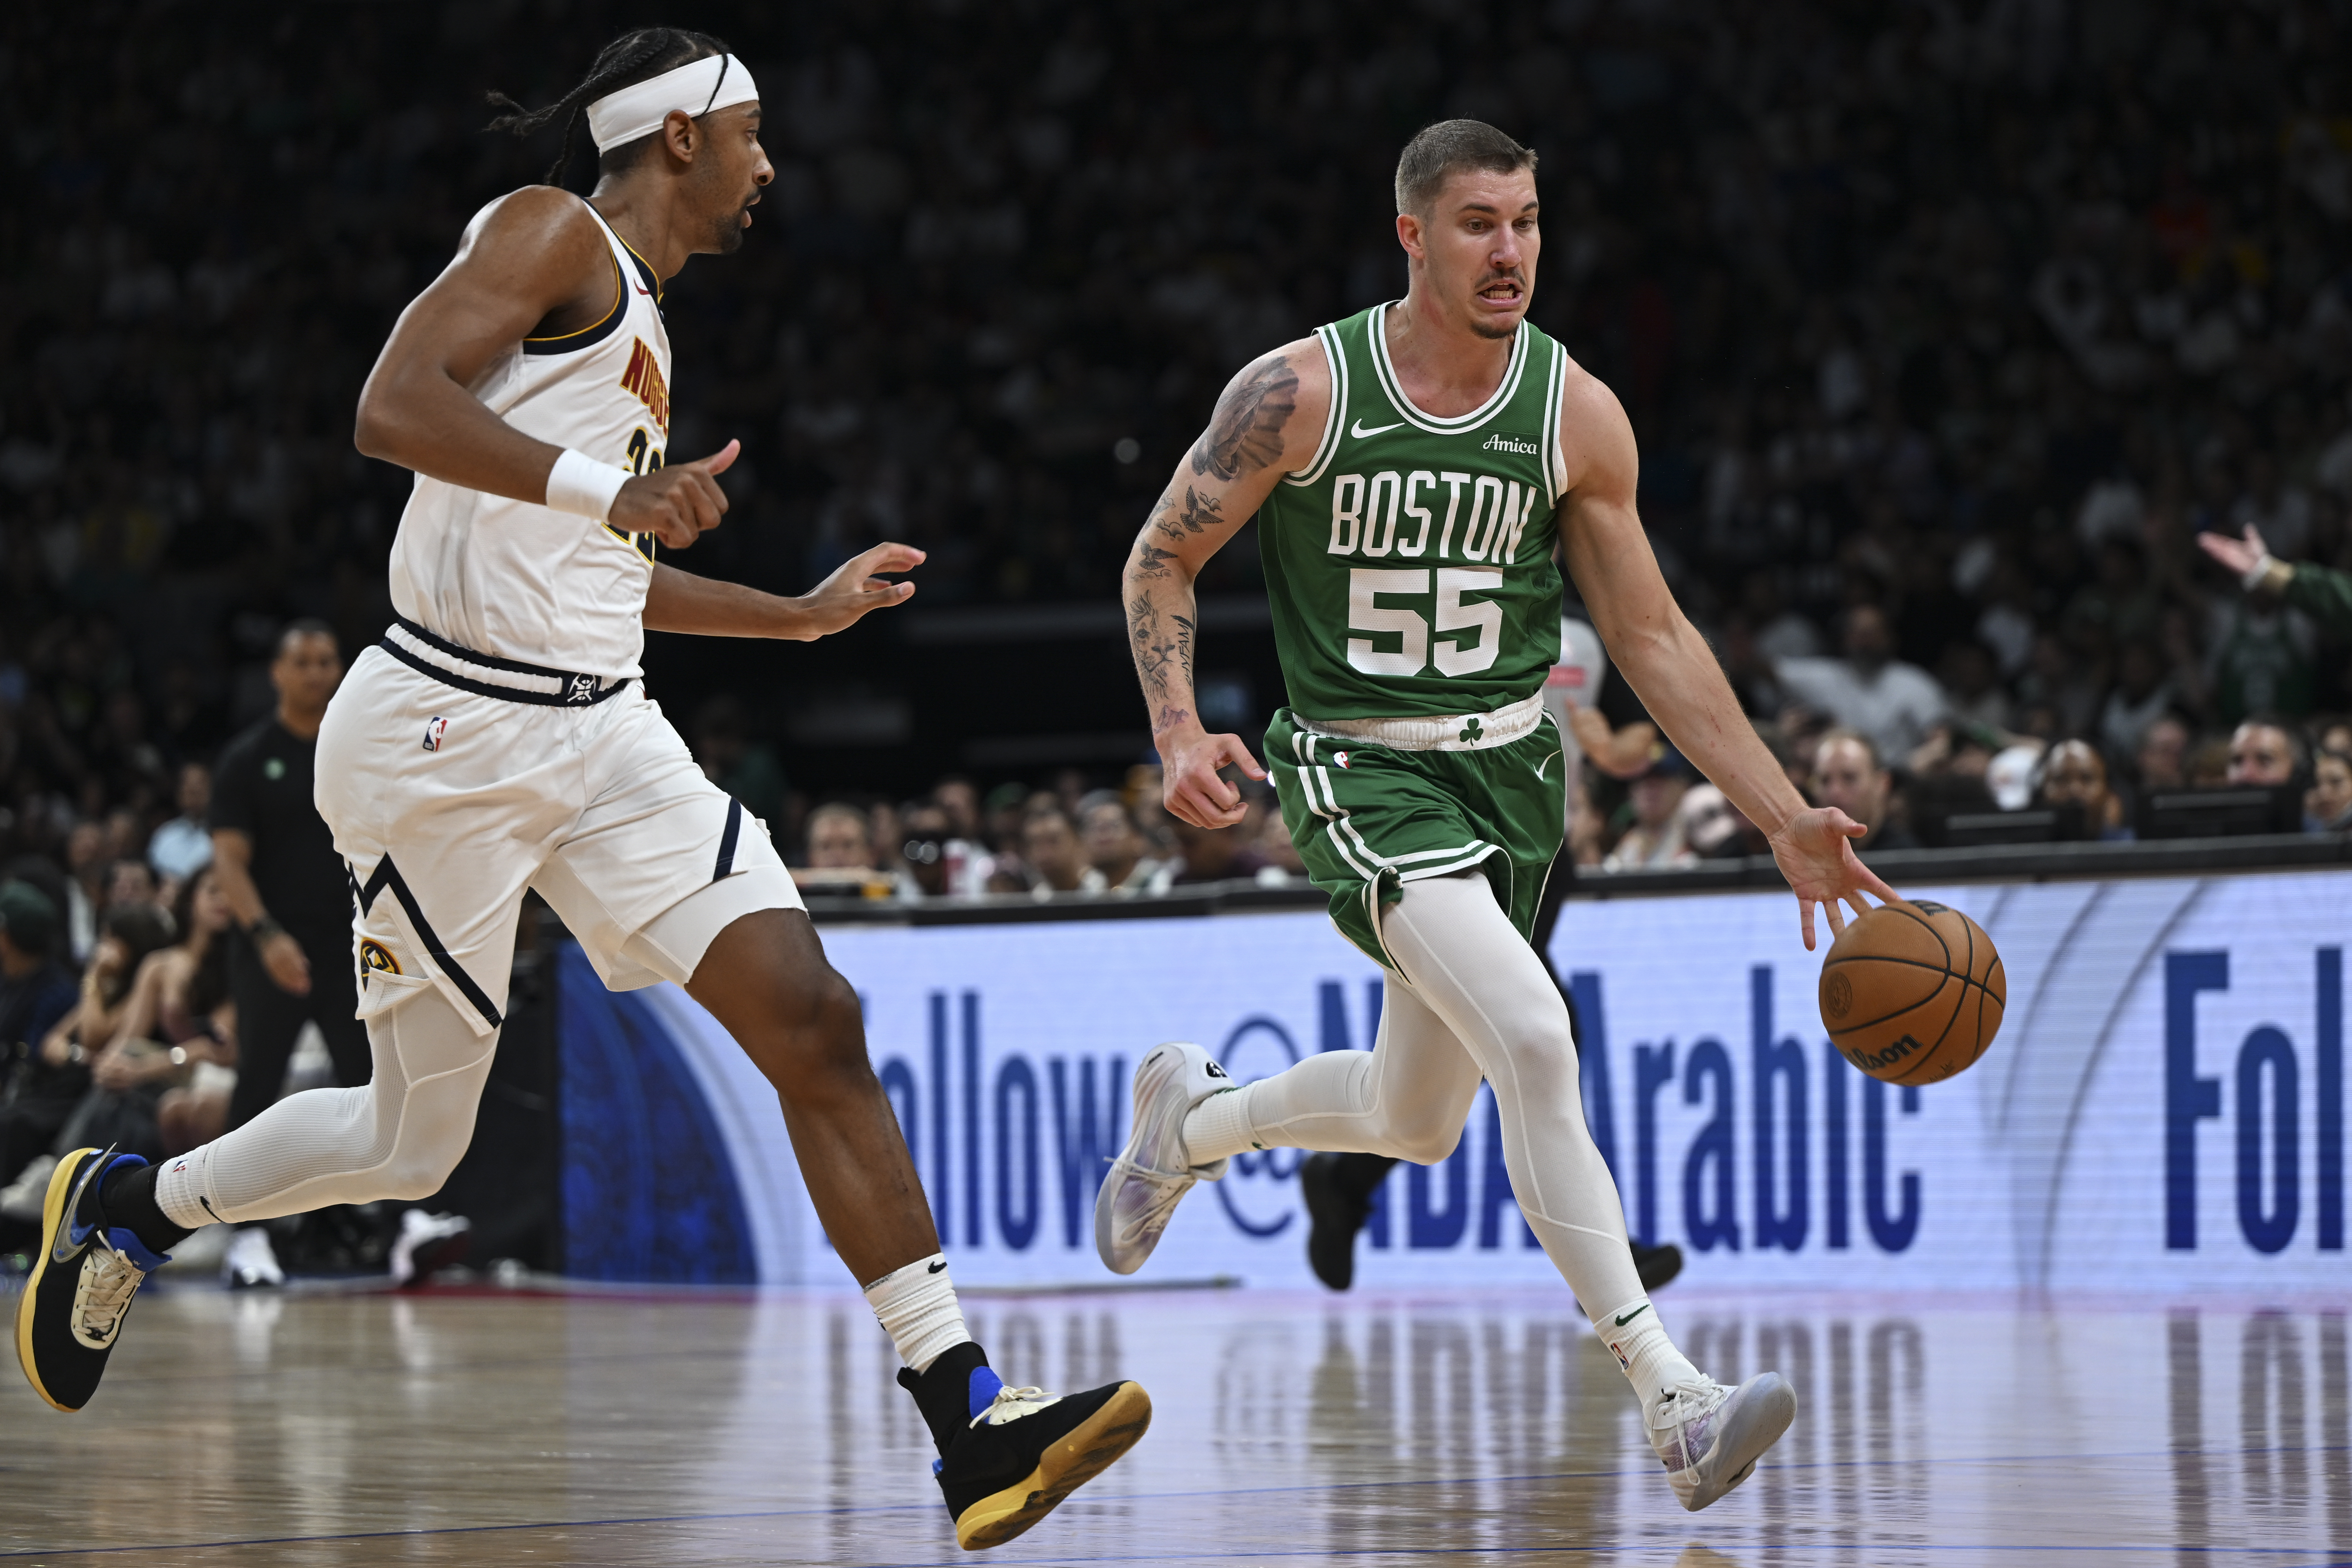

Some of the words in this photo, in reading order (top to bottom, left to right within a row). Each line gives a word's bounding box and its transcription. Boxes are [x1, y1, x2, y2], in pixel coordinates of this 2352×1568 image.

[1483, 434, 1537, 455] Amica
[1327, 470, 1537, 565] BOSTON
[1347, 565, 1504, 677] 55
[1844, 1034, 1924, 1071] lson
[2164, 945, 2344, 1256] Fol
[824, 989, 1127, 1251] llow
